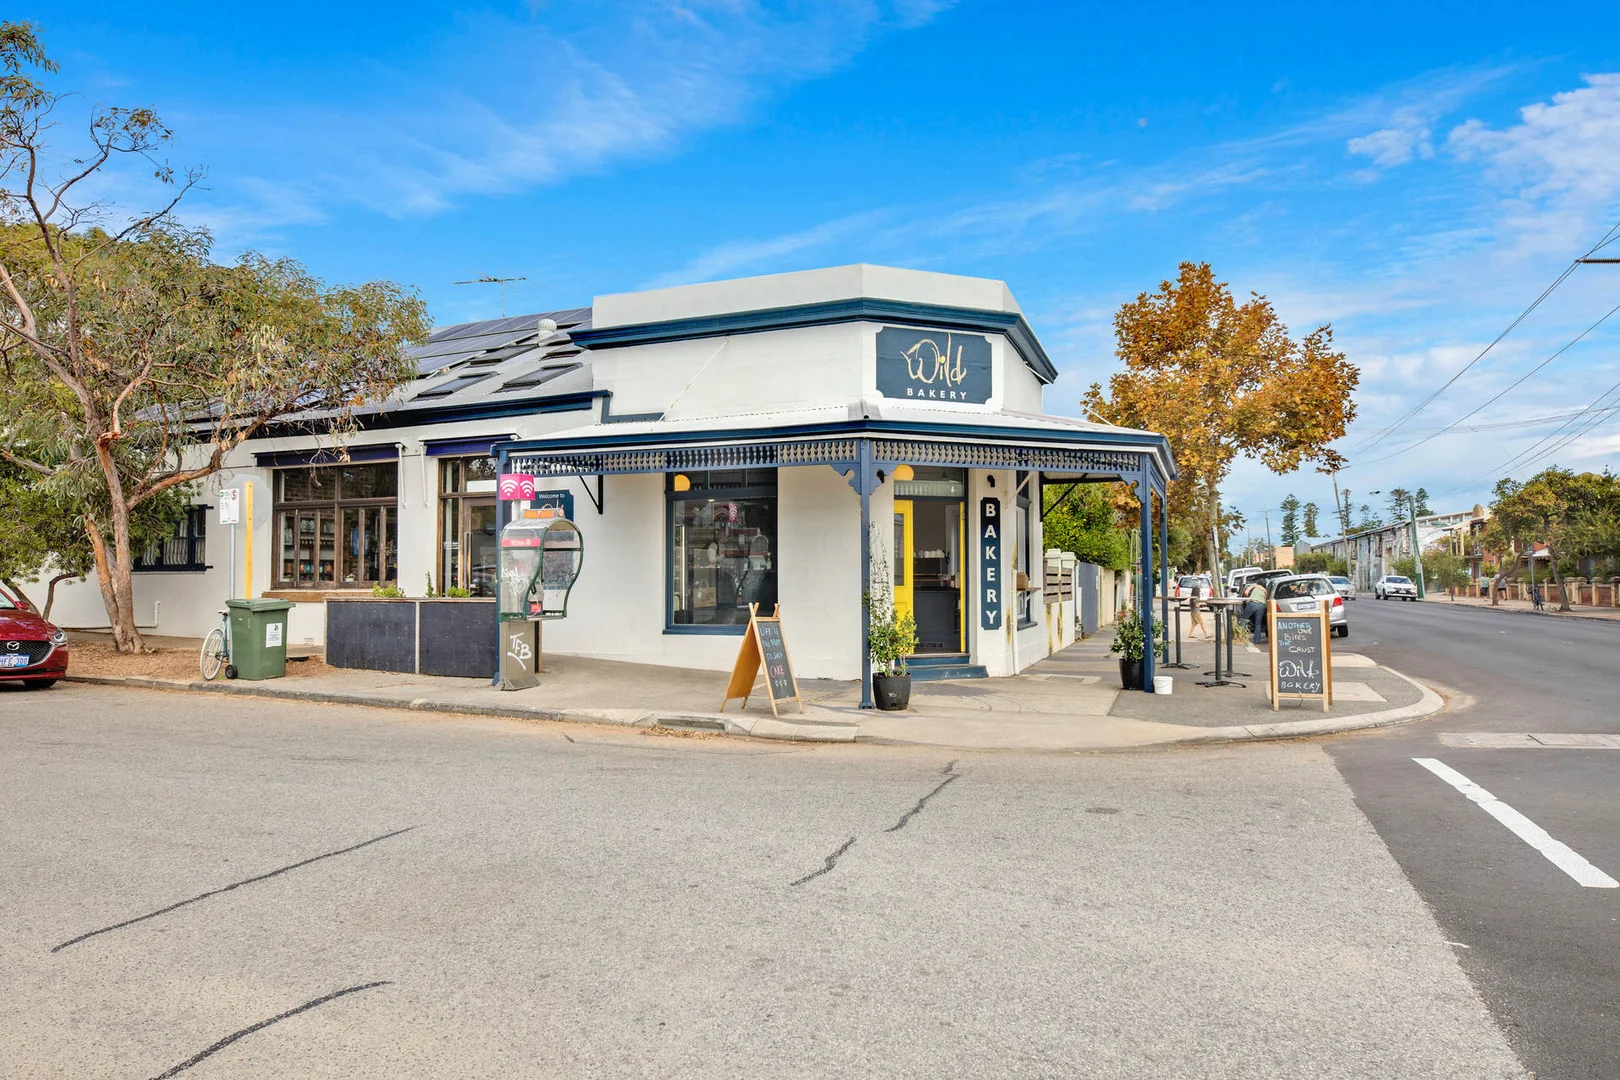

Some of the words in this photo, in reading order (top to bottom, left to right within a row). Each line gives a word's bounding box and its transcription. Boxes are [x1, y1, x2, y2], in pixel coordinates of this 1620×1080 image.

[899, 331, 967, 387] Wild
[906, 387, 967, 400] BAKERY
[984, 503, 997, 624] BAKERY
[1278, 622, 1312, 630] ANOTHER
[1288, 645, 1315, 654] CRUST
[770, 665, 784, 677] CAKE
